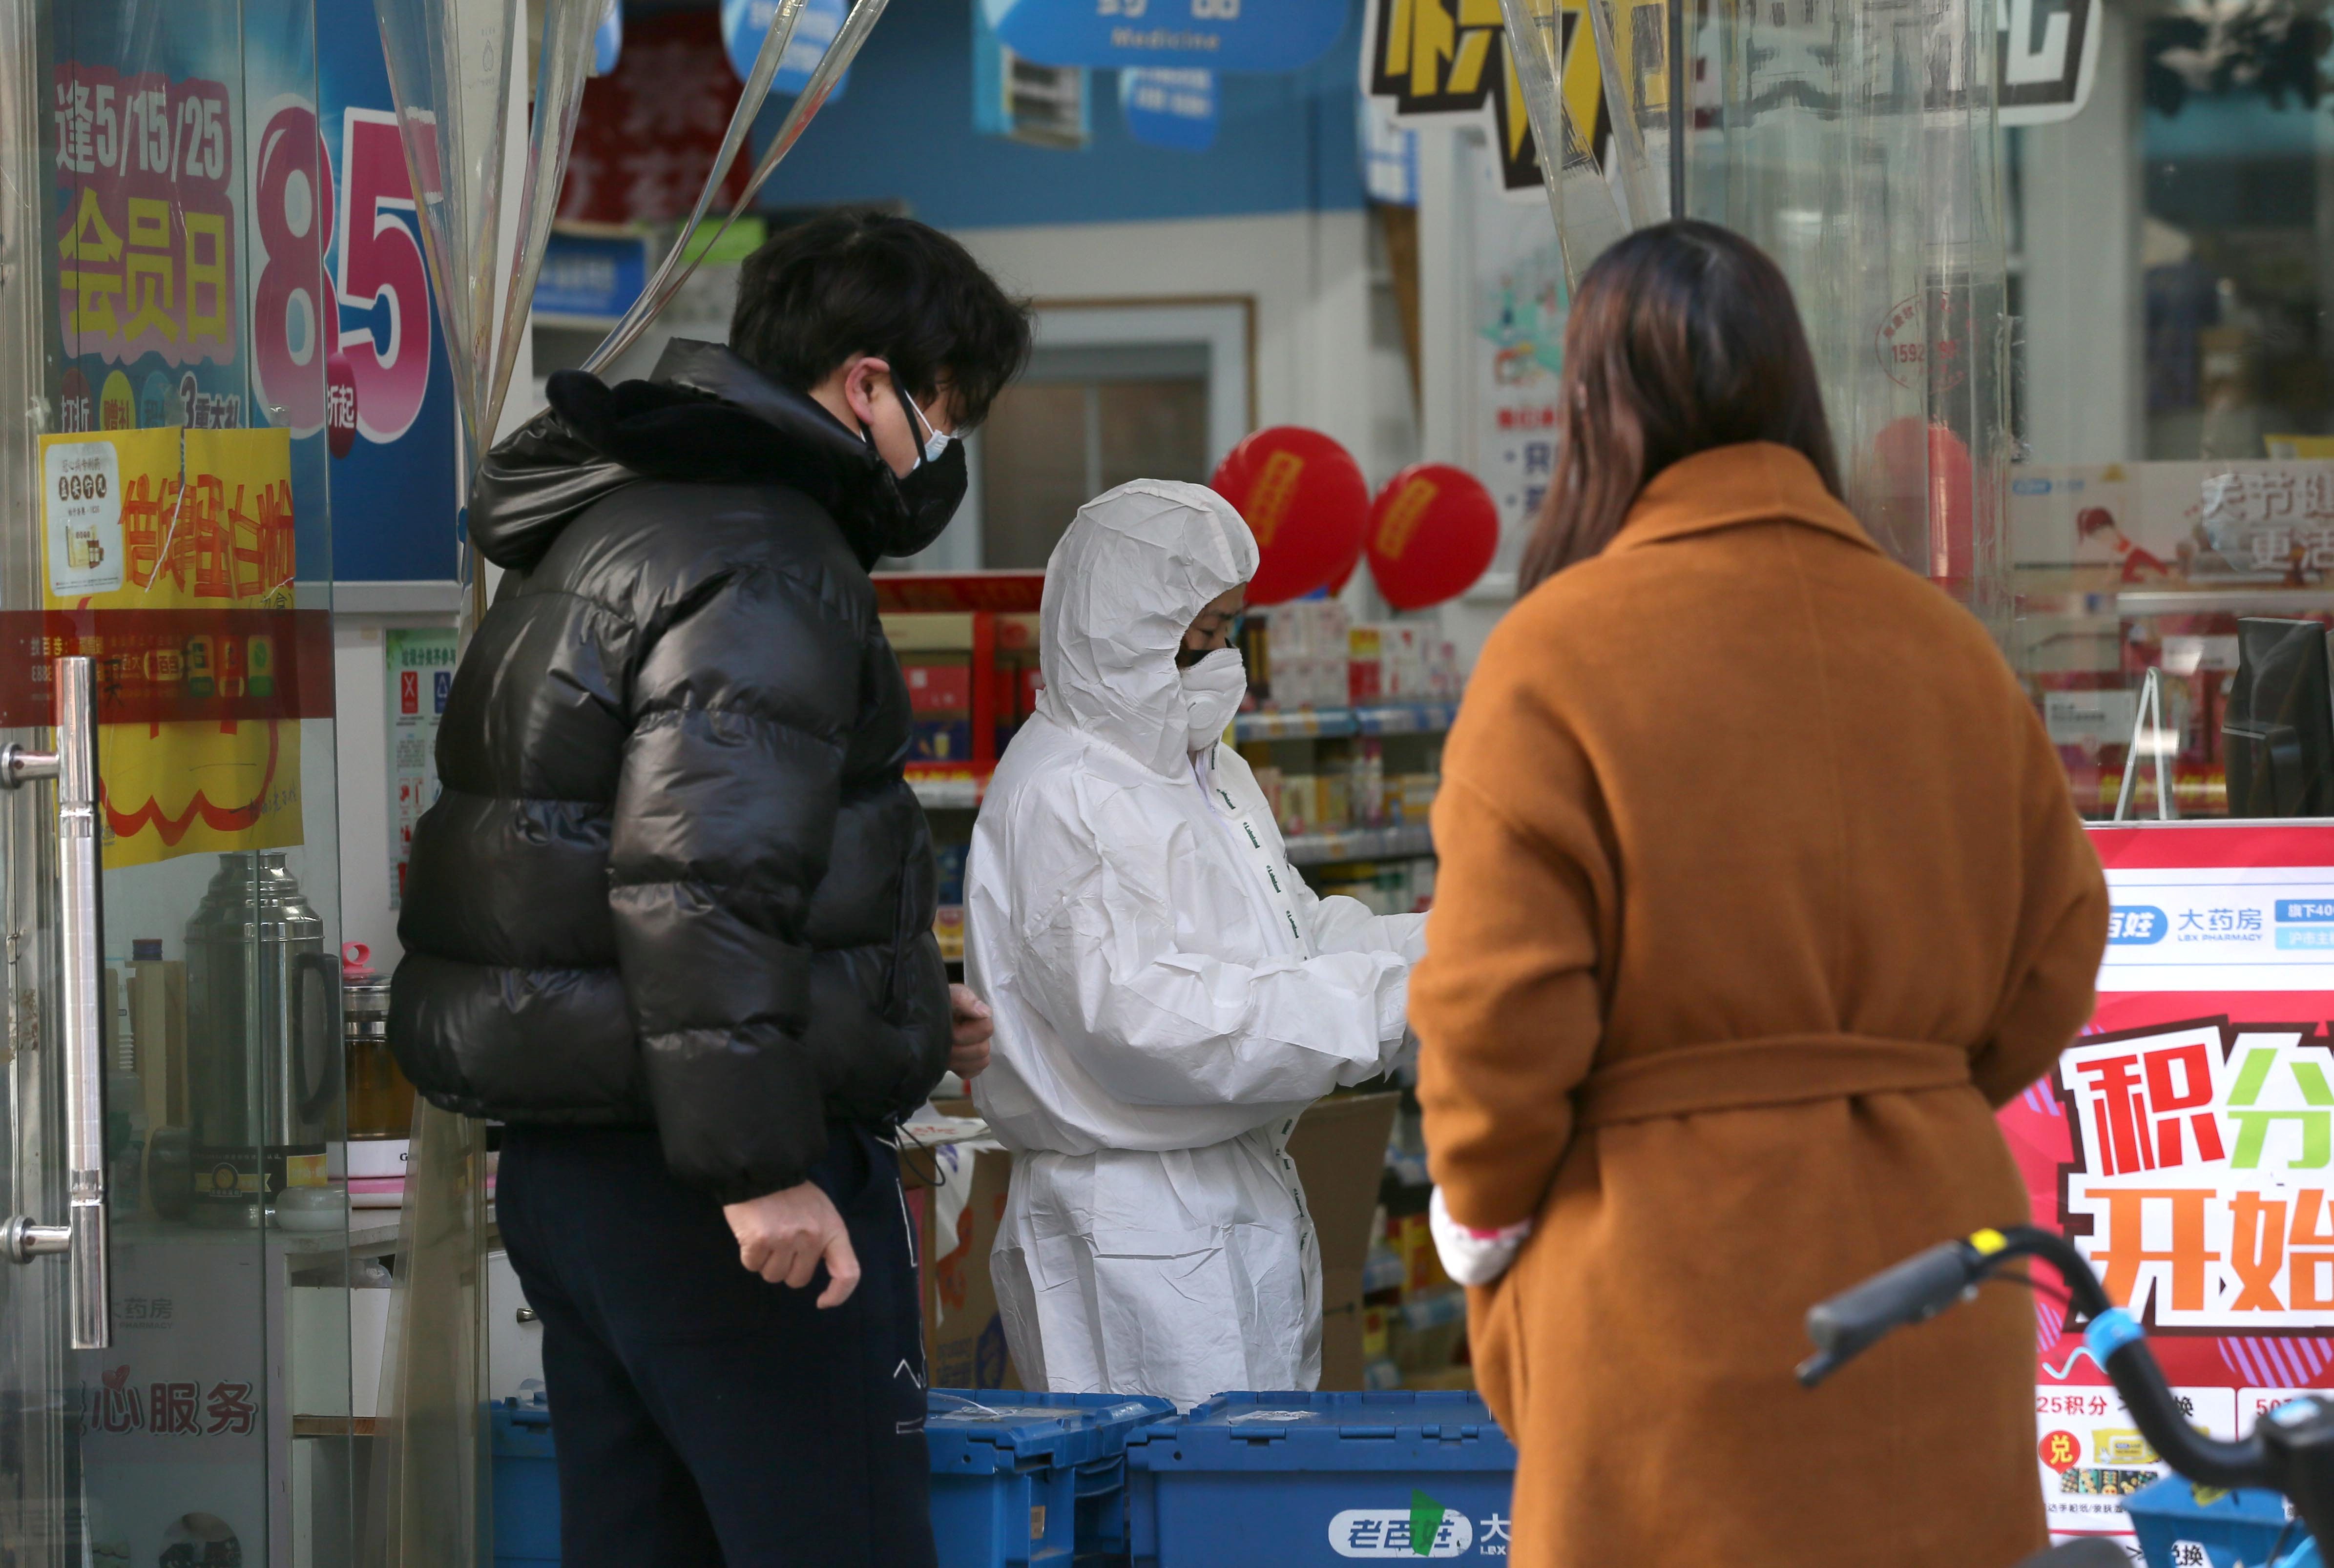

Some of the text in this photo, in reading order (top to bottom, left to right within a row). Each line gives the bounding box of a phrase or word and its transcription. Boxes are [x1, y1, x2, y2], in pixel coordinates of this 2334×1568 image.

[1110, 27, 1219, 51] Medicine
[56, 80, 224, 183] 逢5/15/25
[58, 186, 226, 345] 会员日
[1245, 824, 1260, 849] Lakeland
[1268, 867, 1281, 893] Lakeland
[2178, 908, 2263, 931] 大药房
[2288, 904, 2334, 918] 旗下40
[1288, 912, 1299, 939] Lakeland
[2076, 1043, 2334, 1176] 积分
[2084, 1188, 2334, 1312] 开始
[81, 1365, 257, 1437] 心服务
[2037, 1395, 2107, 1415] 25积分
[2050, 1434, 2073, 1464] 兑
[1348, 1513, 1512, 1549] 老百姓 大
[1480, 1545, 1507, 1556] LBX
